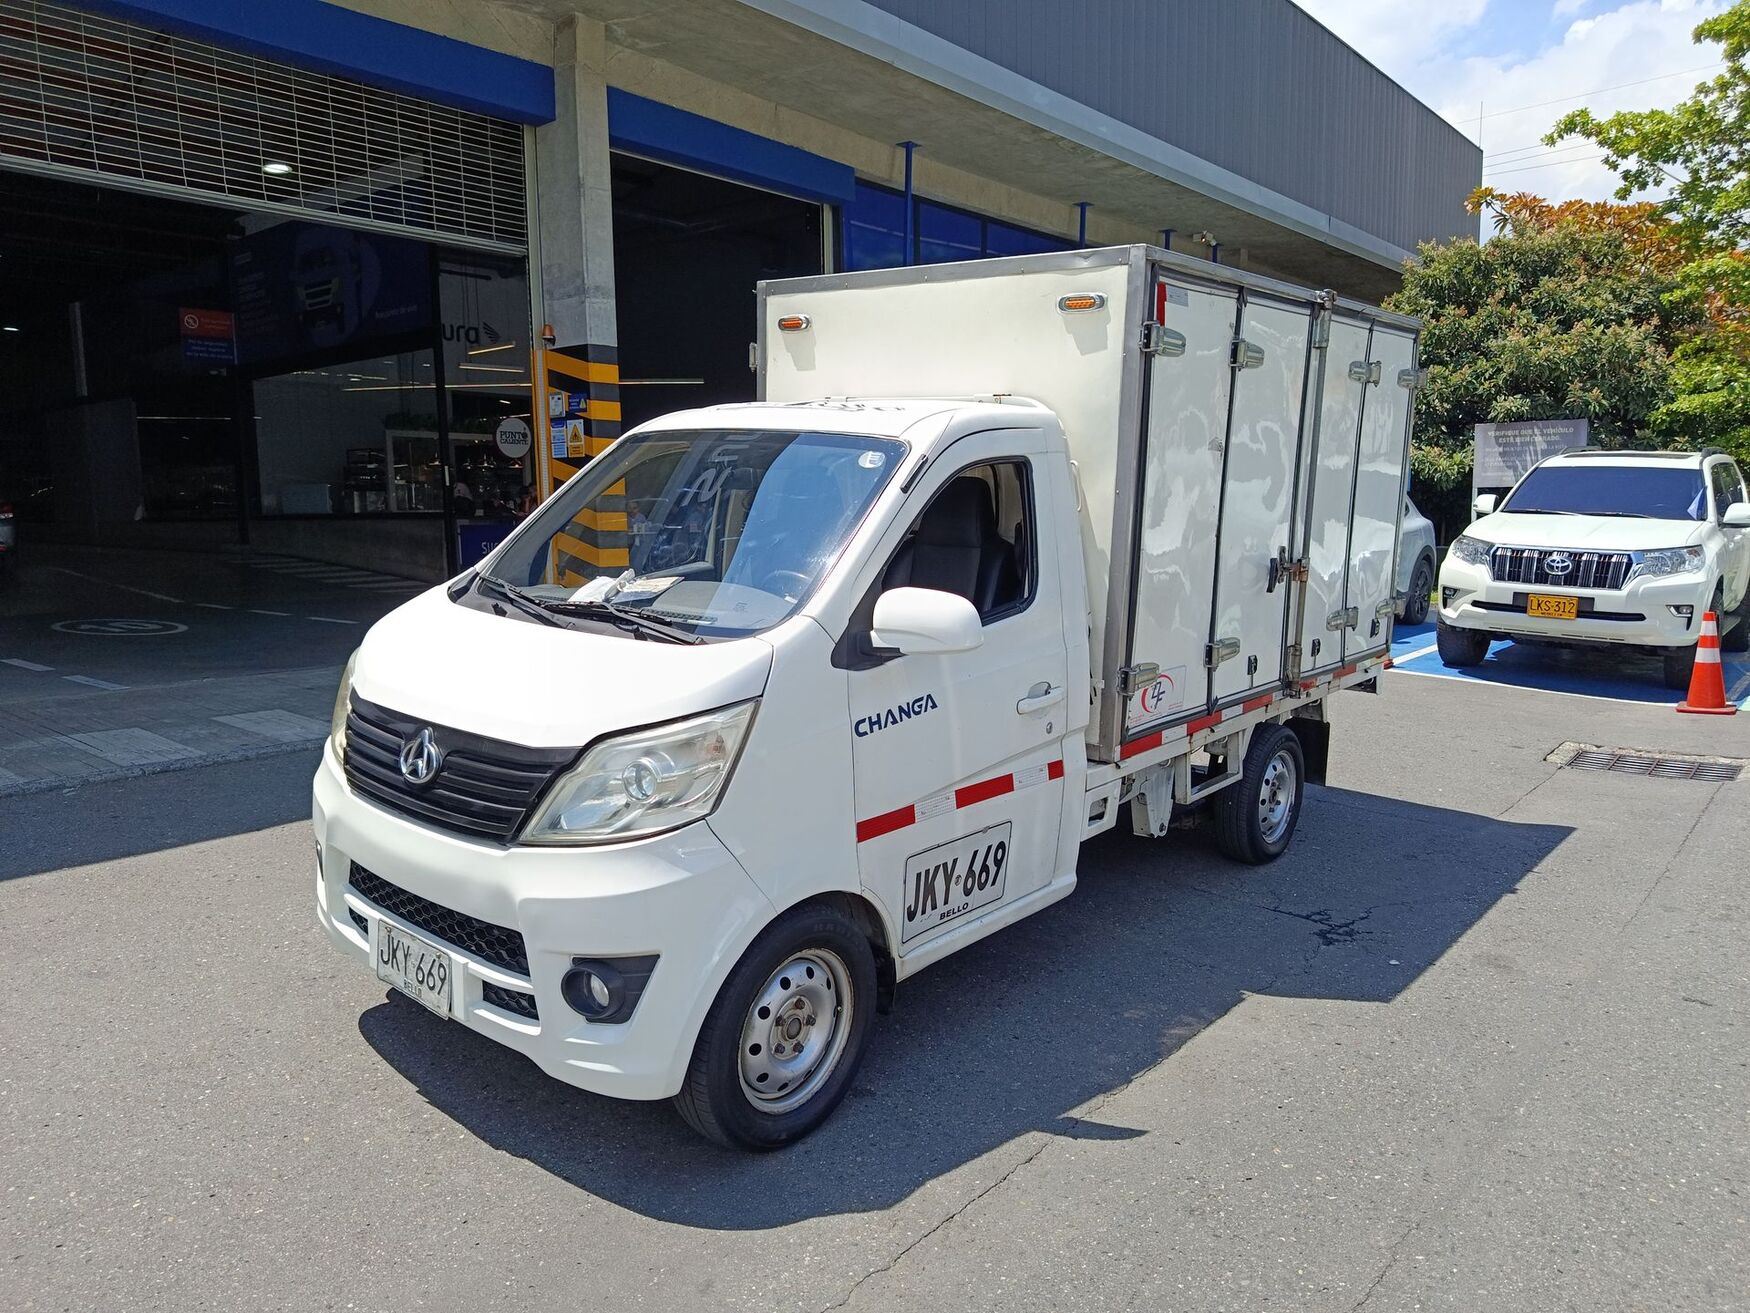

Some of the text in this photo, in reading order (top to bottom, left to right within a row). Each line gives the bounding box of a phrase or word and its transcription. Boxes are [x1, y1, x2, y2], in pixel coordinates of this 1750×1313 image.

[442, 324, 479, 344] ura
[854, 693, 938, 738] CHANGA
[939, 902, 969, 921] BELLO
